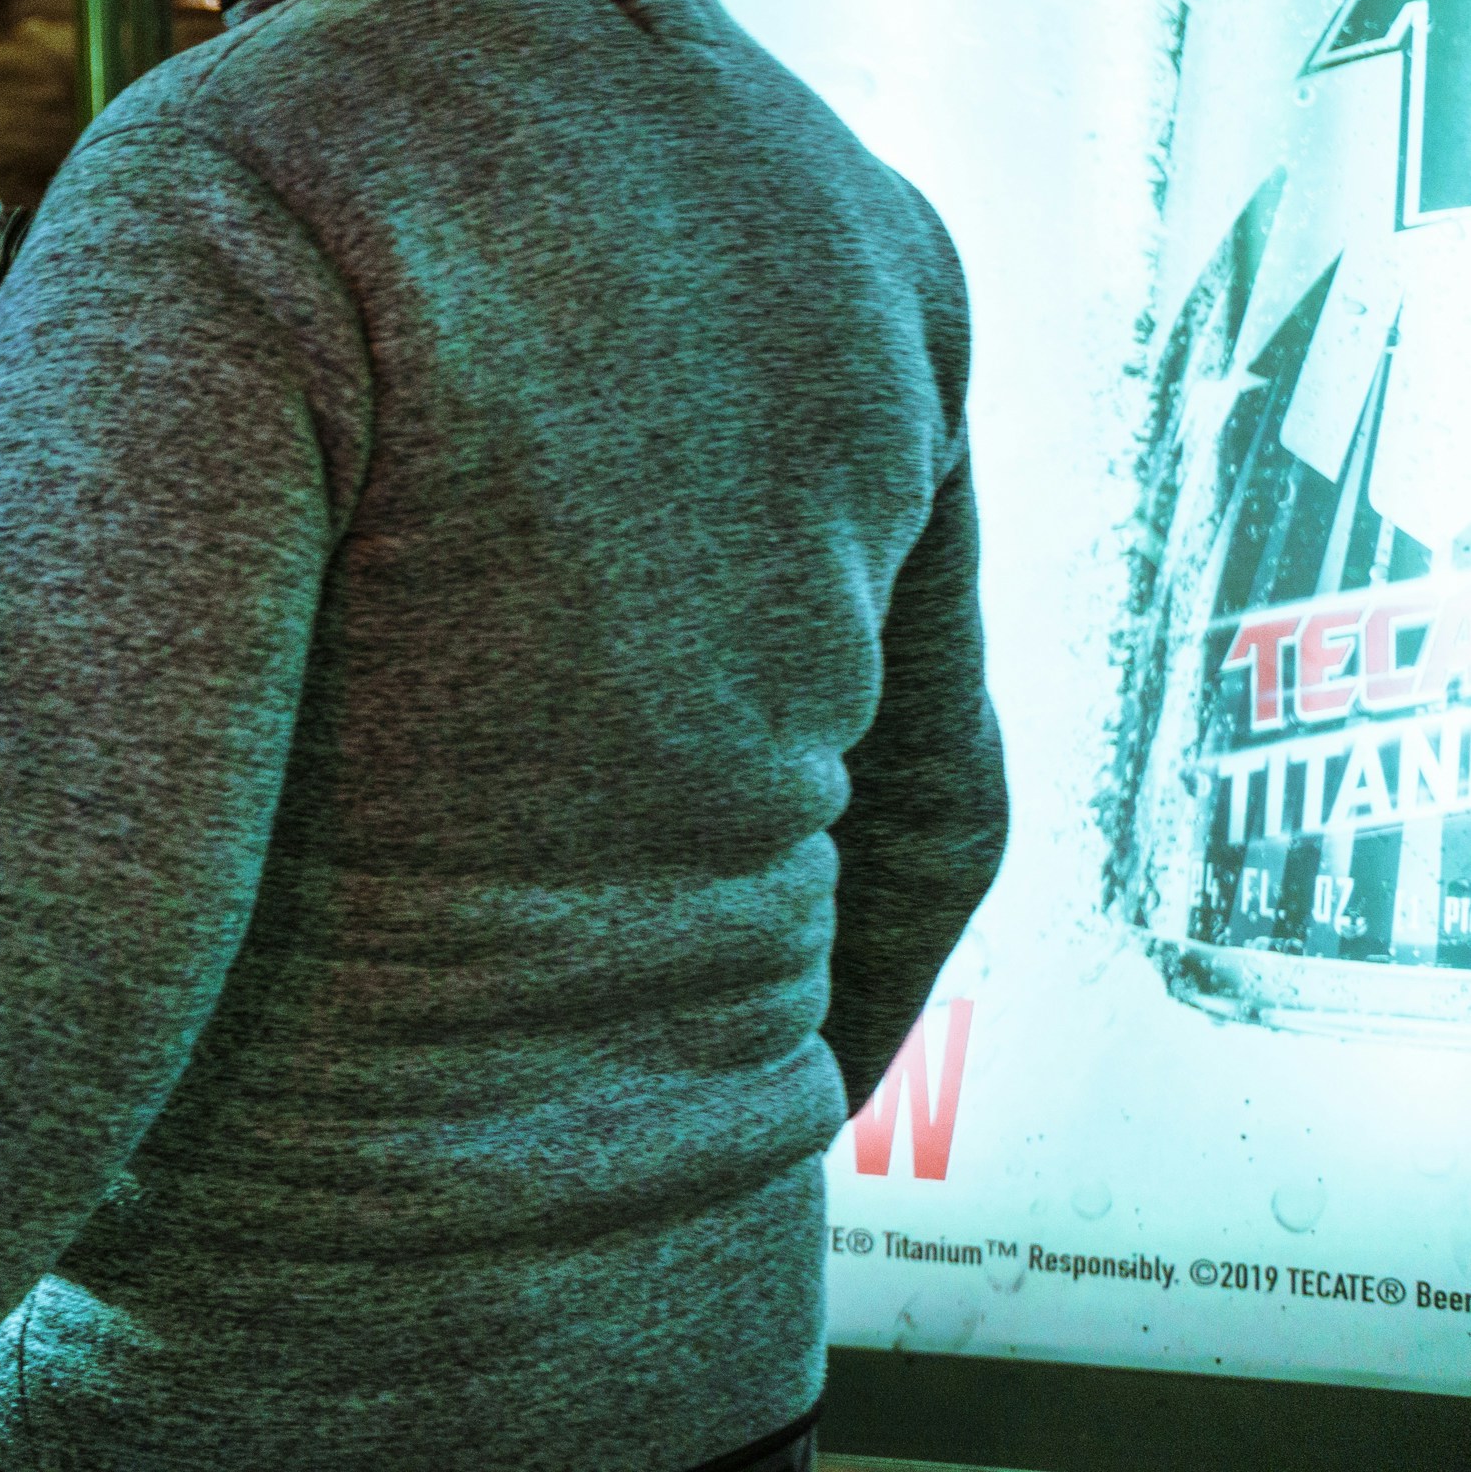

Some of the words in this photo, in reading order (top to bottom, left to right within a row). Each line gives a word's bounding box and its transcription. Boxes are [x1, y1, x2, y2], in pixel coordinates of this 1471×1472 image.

[1028, 1243, 1179, 1290] Responsibly.
[1189, 1258, 1278, 1294] ©2019
[1286, 1266, 1406, 1305] TECATE®
